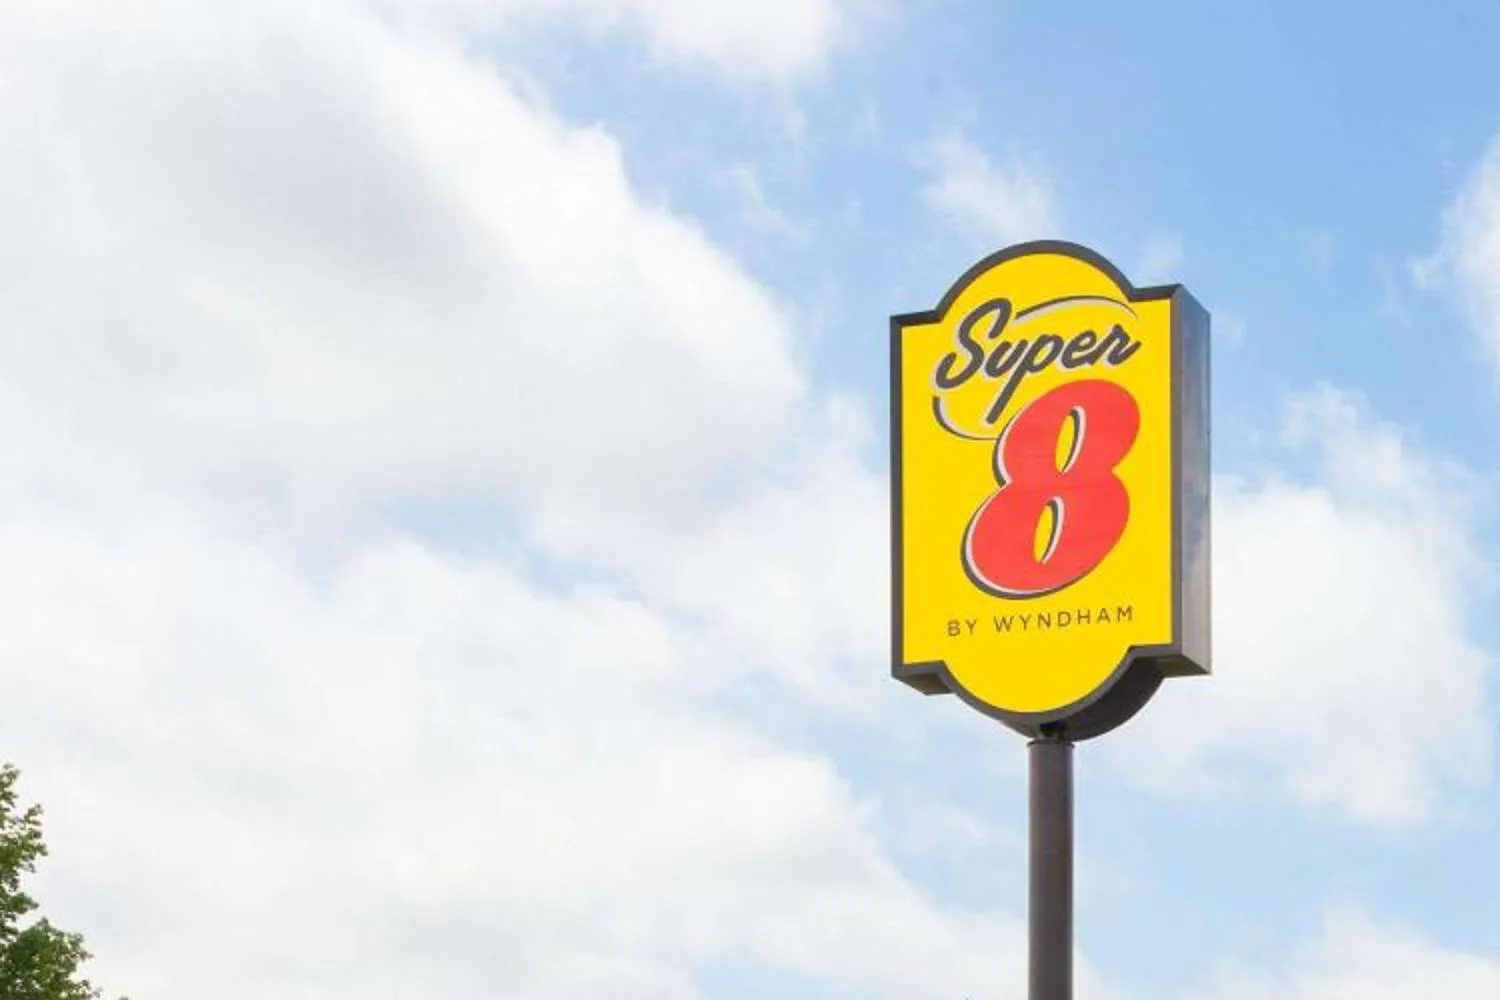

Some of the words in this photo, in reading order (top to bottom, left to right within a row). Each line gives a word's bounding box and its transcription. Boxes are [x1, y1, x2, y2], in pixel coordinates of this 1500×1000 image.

[935, 297, 1142, 425] Super
[962, 379, 1140, 600] 8
[947, 618, 978, 637] BY
[993, 604, 1134, 633] WYNDHAM
